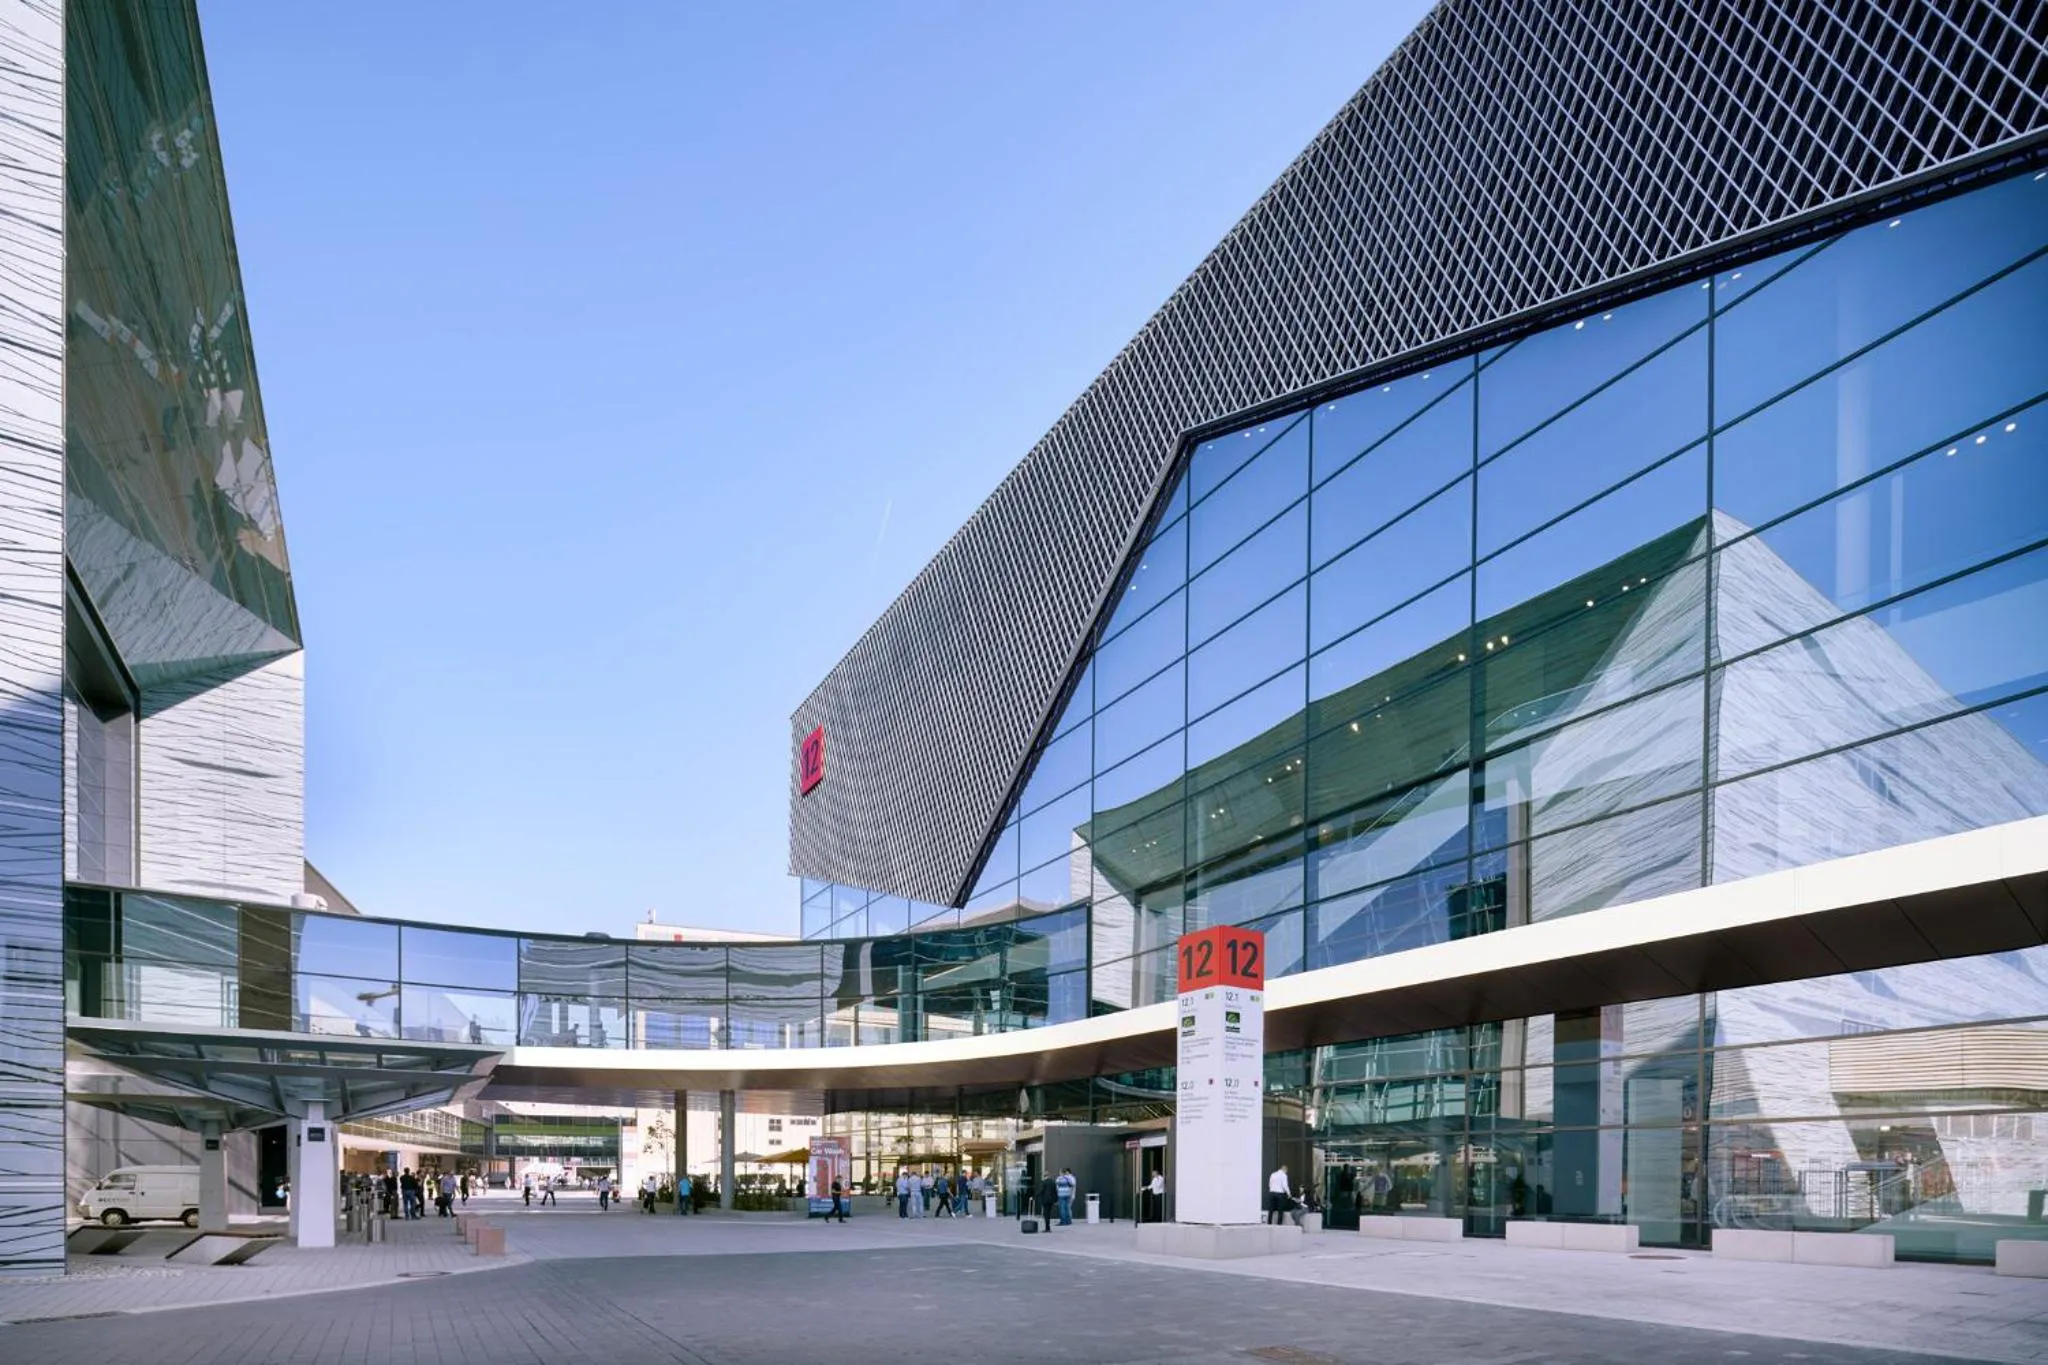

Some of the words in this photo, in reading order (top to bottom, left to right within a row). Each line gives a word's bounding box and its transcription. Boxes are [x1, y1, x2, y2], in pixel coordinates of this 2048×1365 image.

[804, 739, 819, 780] 12
[1183, 940, 1213, 980] 12
[1226, 939, 1258, 978] 12
